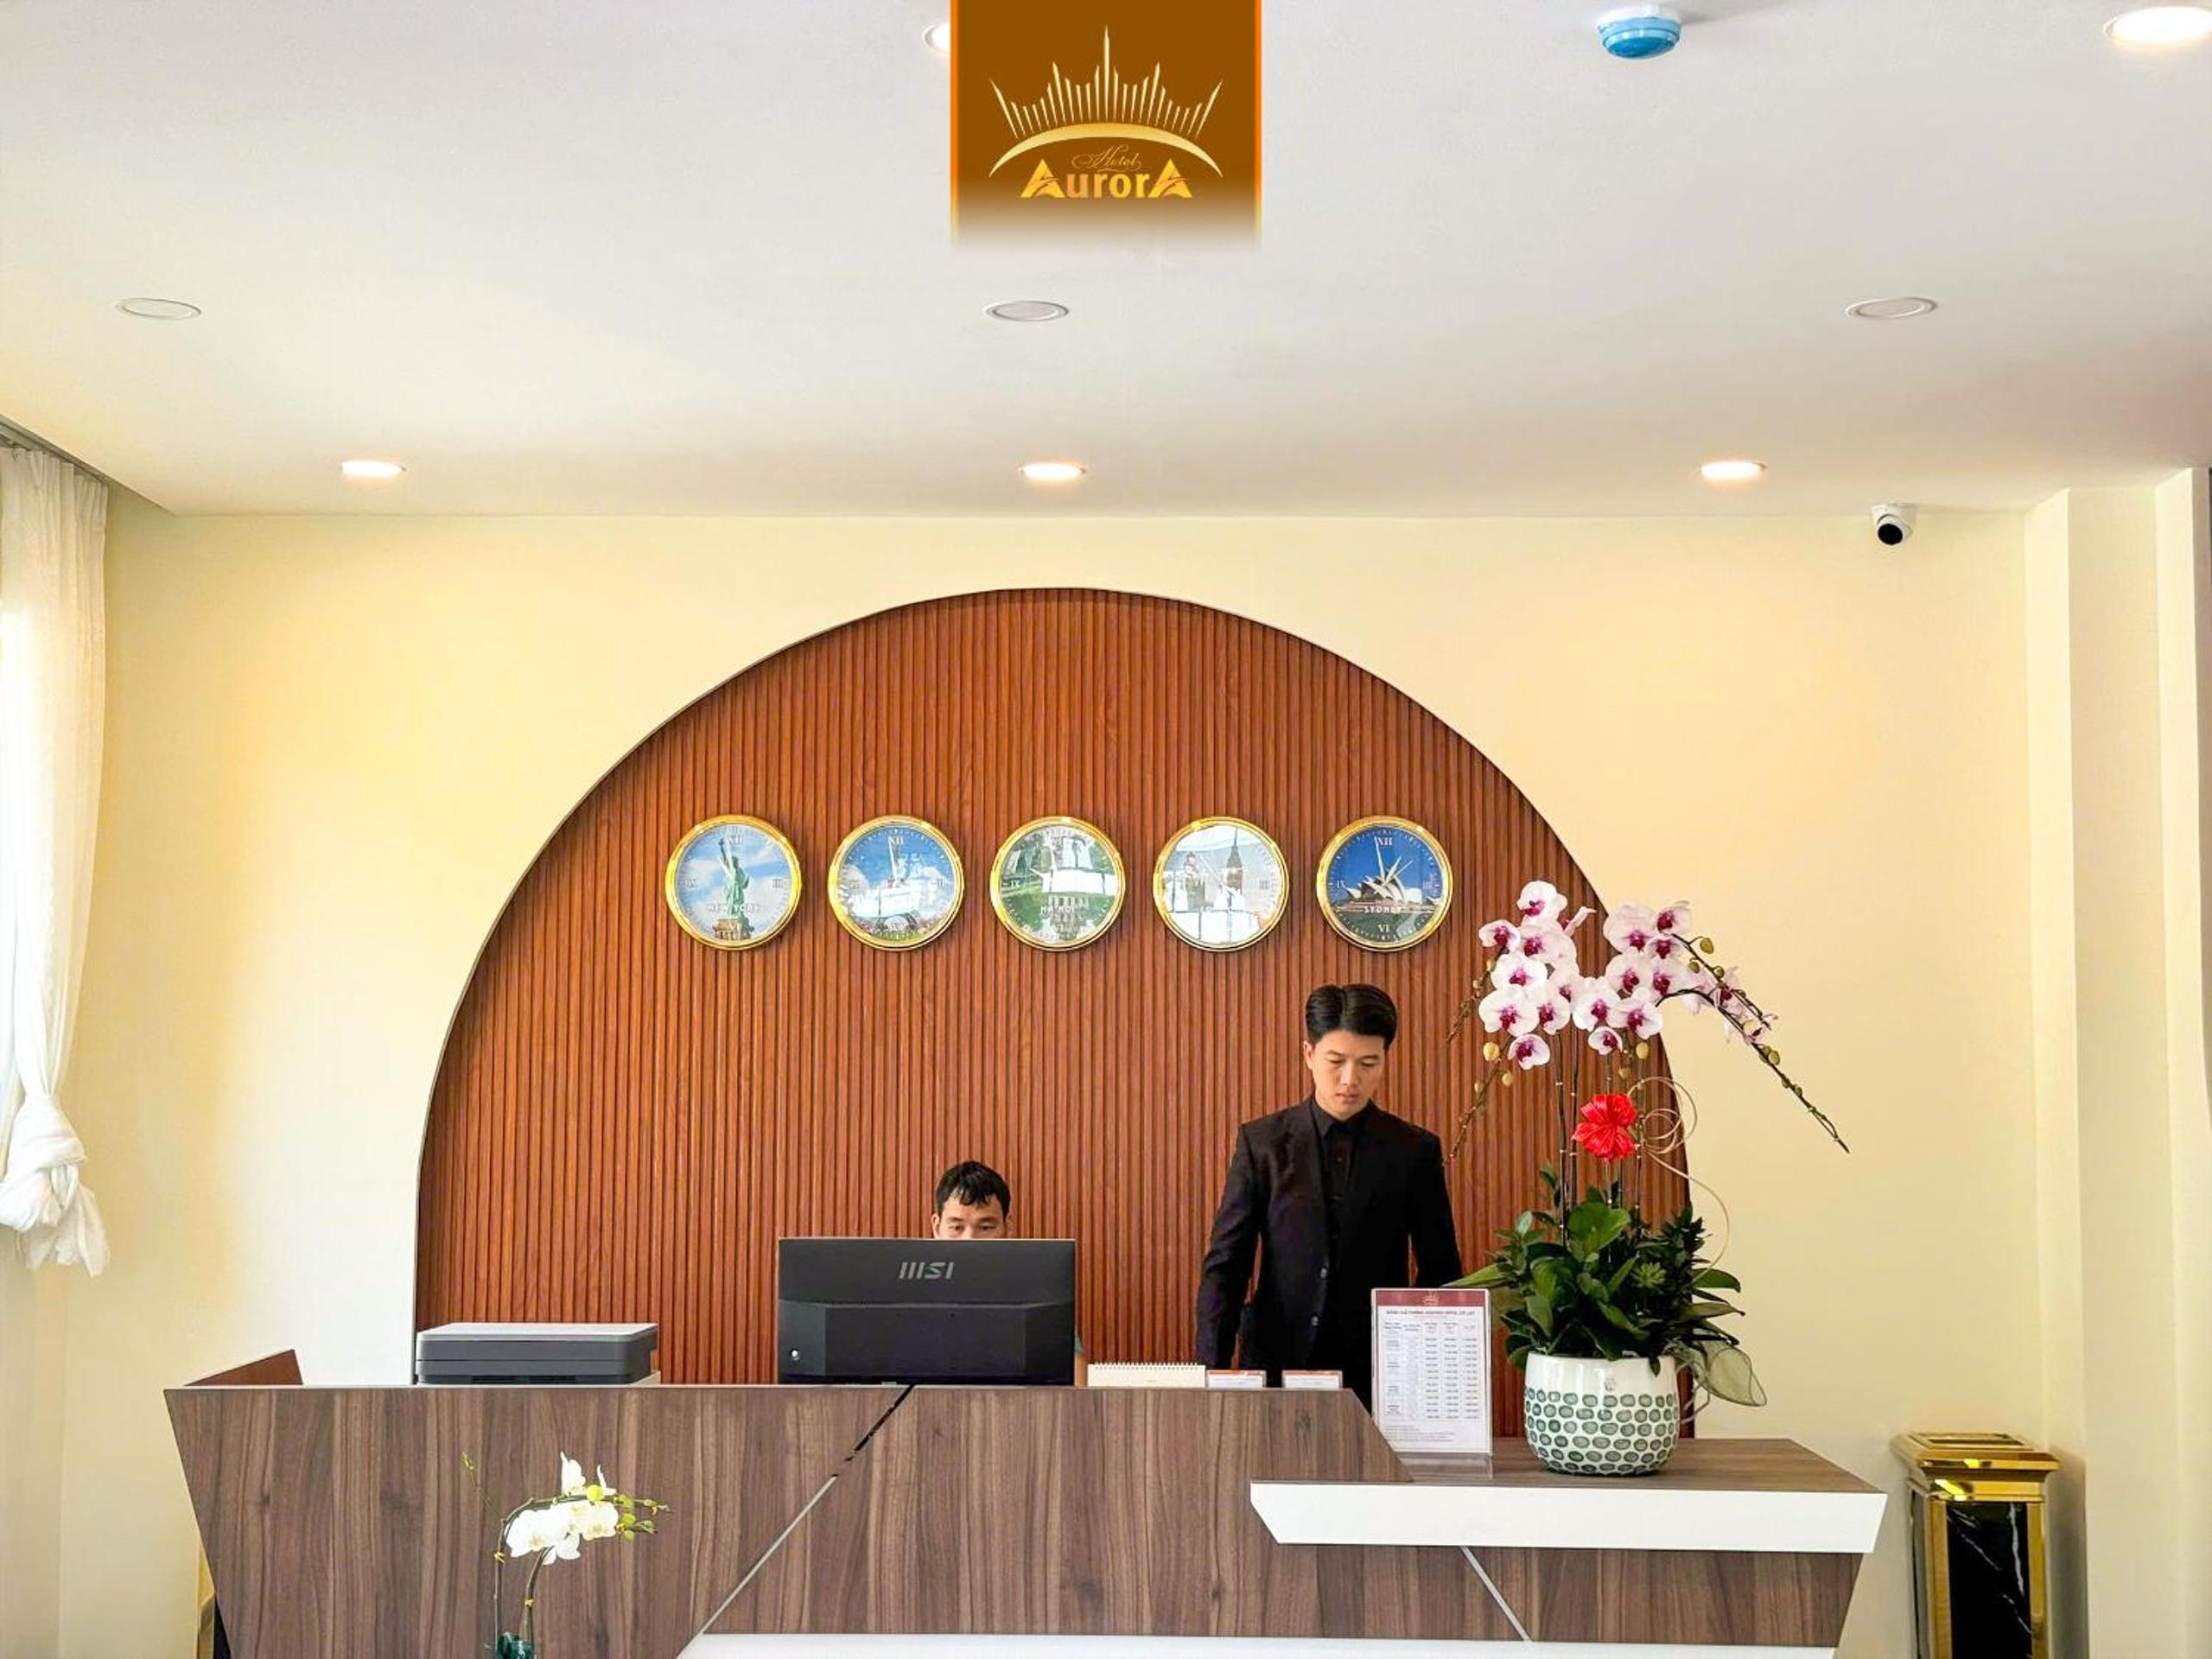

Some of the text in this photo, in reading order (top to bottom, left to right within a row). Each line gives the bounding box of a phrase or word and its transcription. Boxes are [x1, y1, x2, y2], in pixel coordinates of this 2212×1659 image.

[1377, 836, 1393, 846] XII
[1363, 906, 1402, 914] SYDNEY
[1377, 923, 1390, 933] VI
[899, 1262, 954, 1280] MSI
